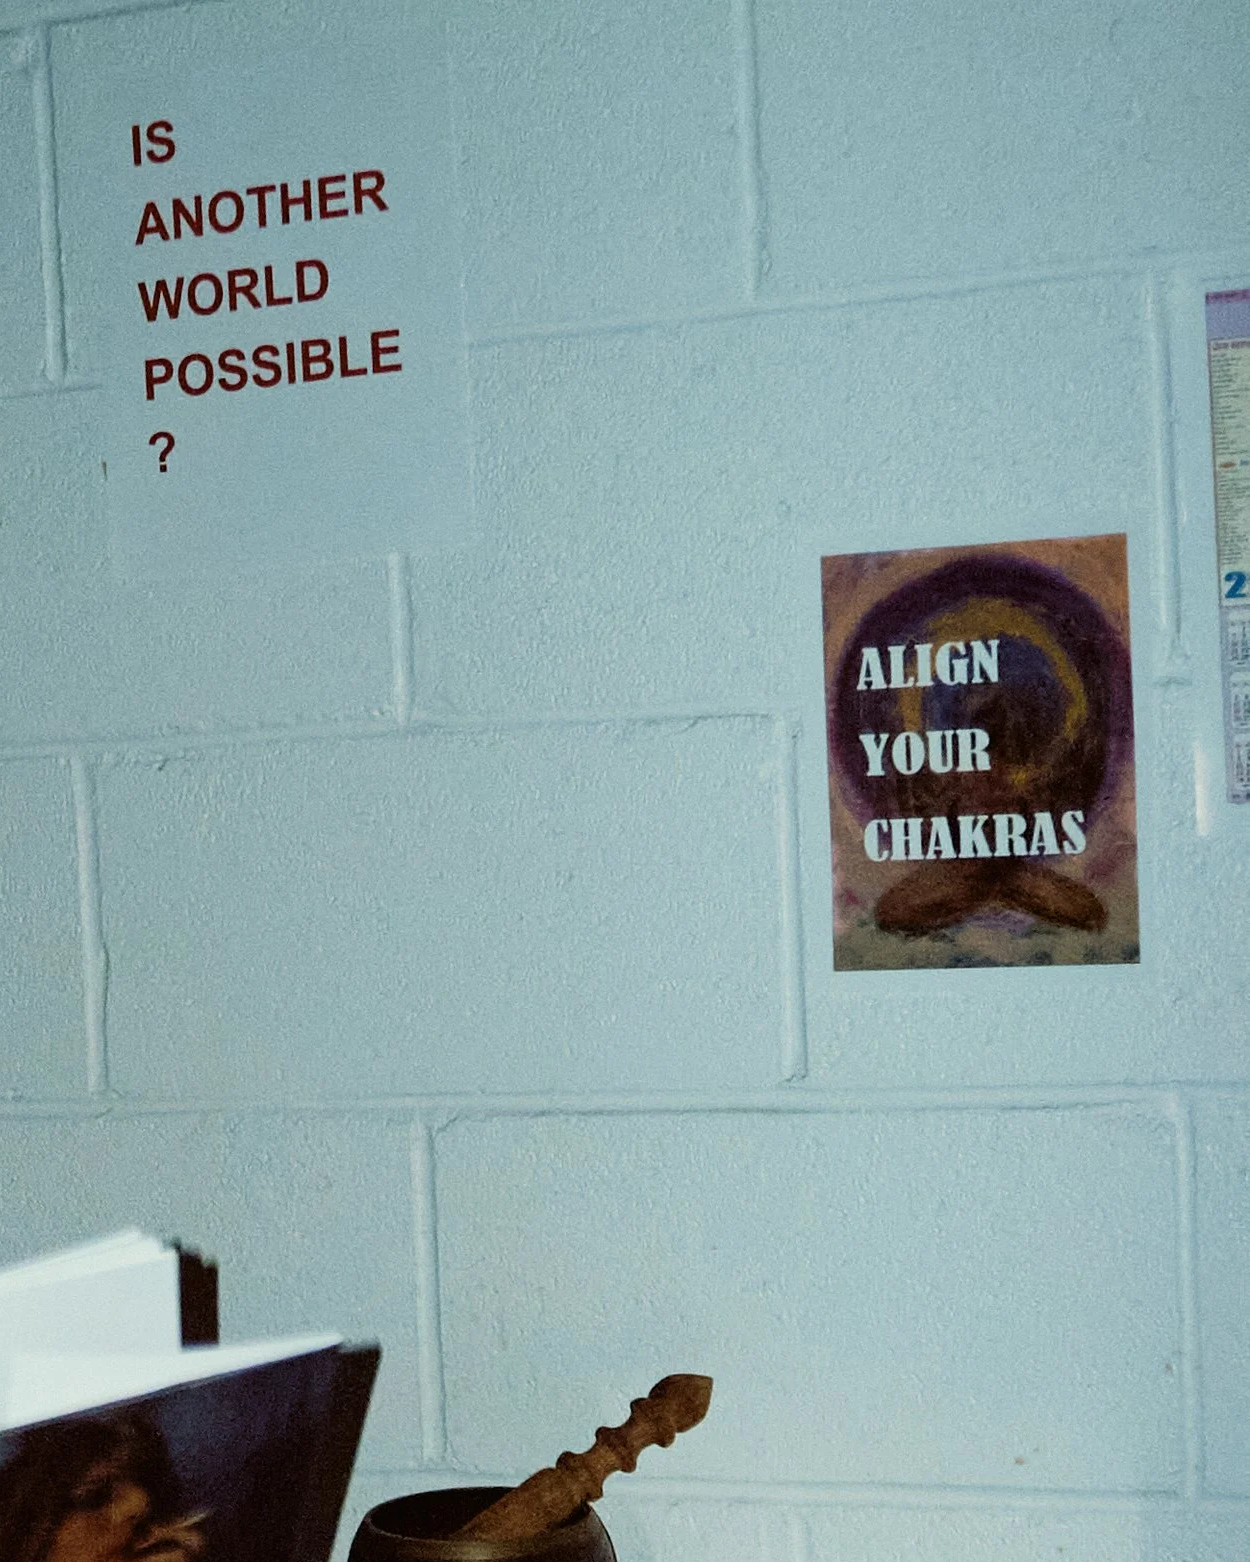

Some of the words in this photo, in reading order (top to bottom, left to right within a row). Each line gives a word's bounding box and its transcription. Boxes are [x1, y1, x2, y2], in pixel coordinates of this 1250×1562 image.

[131, 120, 176, 167] IS
[135, 169, 389, 246] ANOTHER
[137, 259, 330, 323] WORLD
[145, 328, 403, 401] POSSIBLE
[148, 431, 176, 473] ?
[856, 639, 1000, 691] ALIGN
[859, 728, 992, 777] YOUR
[863, 809, 1088, 863] CHAKRAS
